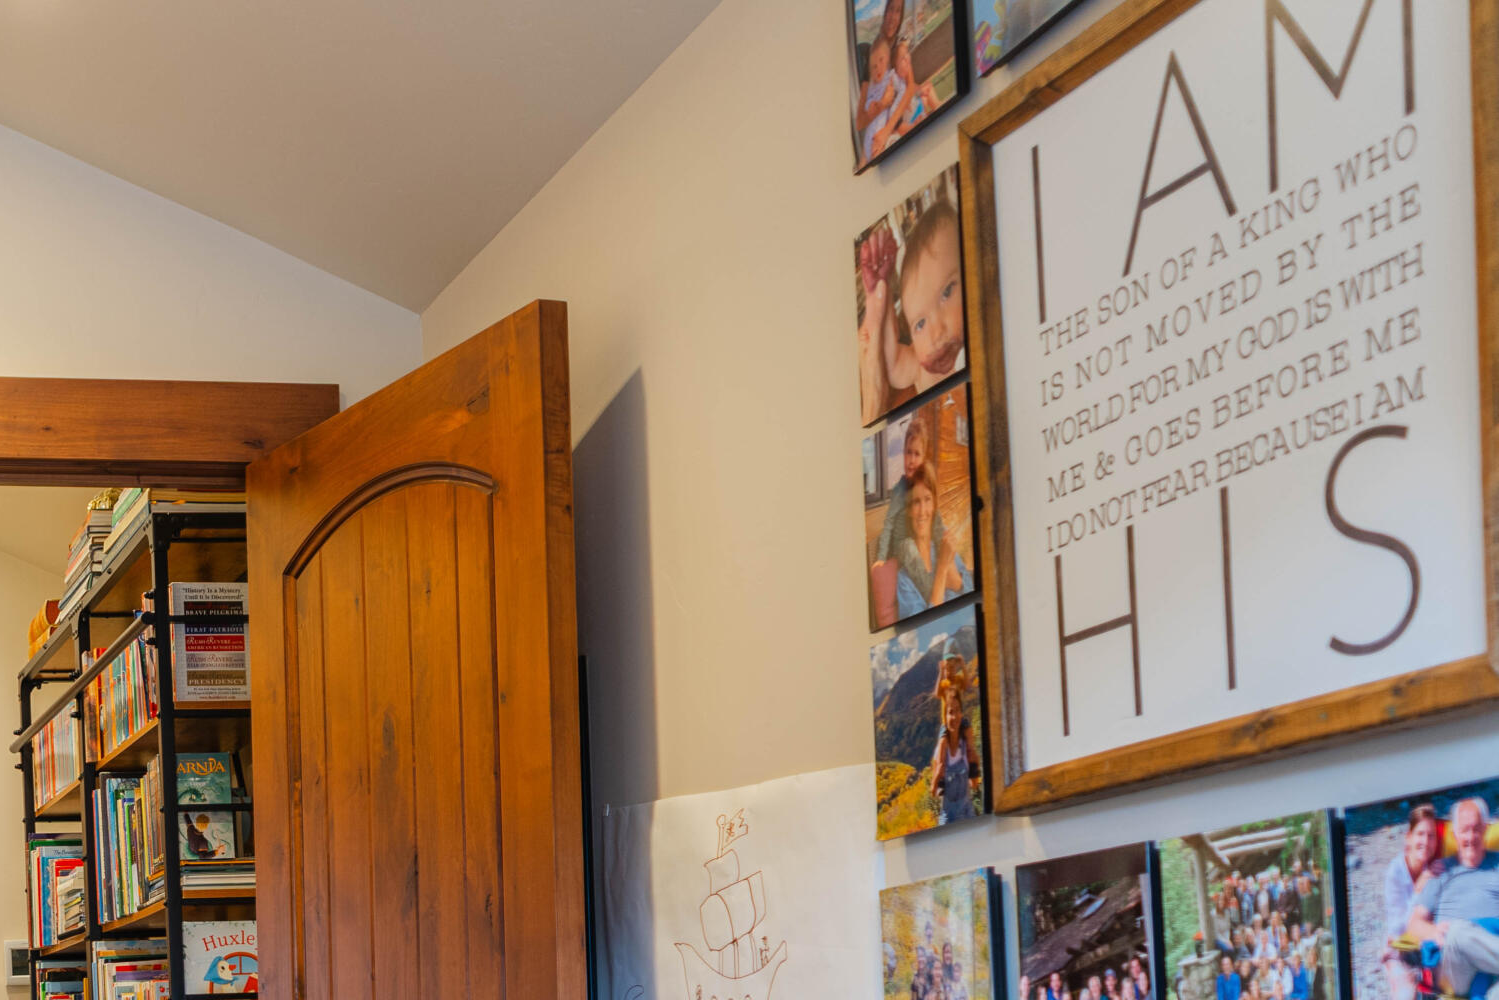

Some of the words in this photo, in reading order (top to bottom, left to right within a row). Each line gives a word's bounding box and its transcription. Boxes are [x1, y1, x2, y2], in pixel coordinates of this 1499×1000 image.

[1031, 145, 1047, 324] I
[1122, 0, 1416, 277] AM
[1039, 307, 1090, 357] THE
[1098, 271, 1151, 326] SON
[1158, 246, 1198, 291] OF
[1206, 232, 1229, 267] A
[1238, 177, 1322, 250] KING
[1334, 123, 1418, 192] WHO
[1040, 371, 1065, 407] IS
[1074, 335, 1134, 389] NOT
[1145, 268, 1262, 353] MOVED
[1276, 232, 1325, 287] BY
[1340, 183, 1421, 251] THE
[1041, 393, 1126, 454] WORLD
[1128, 366, 1181, 414] FOR
[1186, 338, 1231, 387] MY
[1236, 307, 1299, 360] GOD
[1303, 288, 1332, 331] IS
[1337, 242, 1426, 310] WITH
[1046, 462, 1086, 503] ME
[1094, 454, 1116, 481] &
[1124, 406, 1201, 467] GOES
[1211, 340, 1351, 430] BEFORE
[1363, 306, 1422, 362] ME
[1046, 525, 1055, 553] I
[1056, 512, 1087, 549] DO
[1088, 489, 1139, 536] NOT
[1139, 459, 1211, 514] FEAR
[1215, 398, 1350, 484] BECAUSE
[1352, 393, 1365, 426] I
[1369, 366, 1428, 421] AM
[1054, 425, 1421, 737] HIS
[202, 930, 258, 952] Huxle
